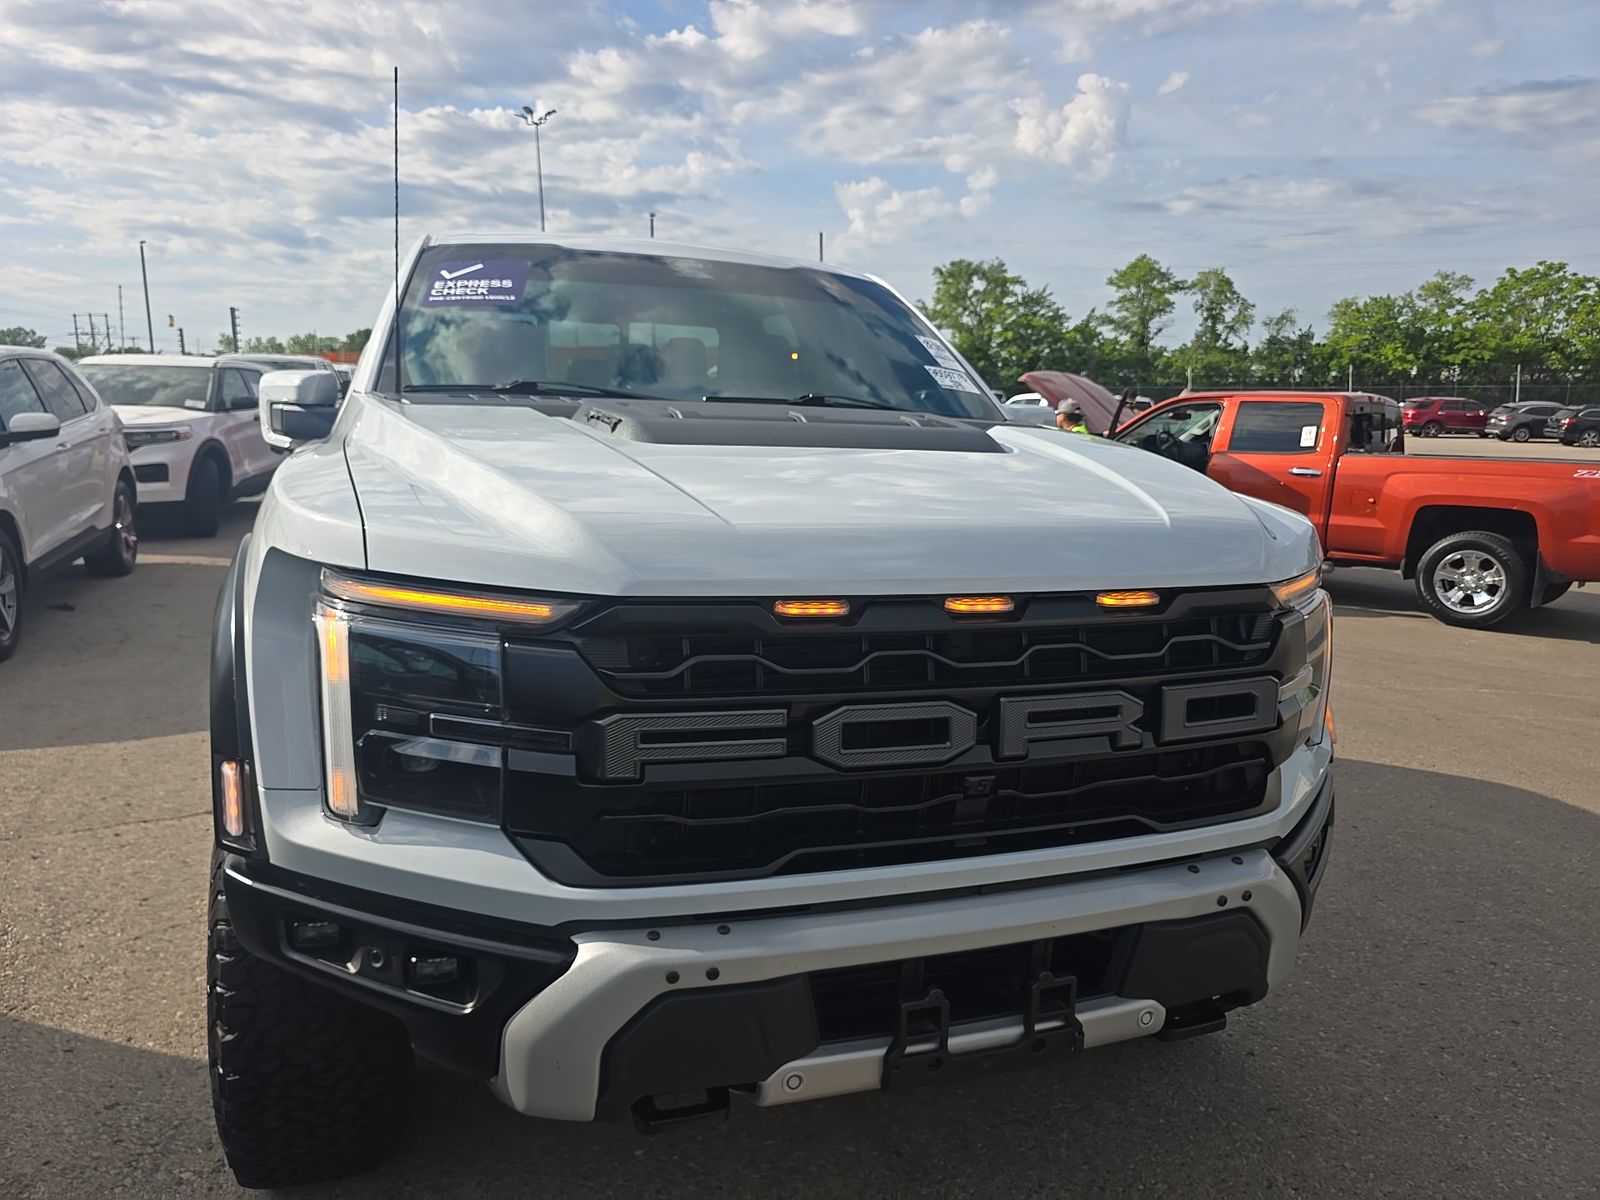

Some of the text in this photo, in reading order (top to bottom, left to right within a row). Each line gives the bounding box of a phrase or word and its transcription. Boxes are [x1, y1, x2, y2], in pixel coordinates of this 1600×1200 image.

[433, 280, 512, 289] EXPRESS
[431, 288, 488, 296] CHECK
[599, 676, 1279, 780] FORD
